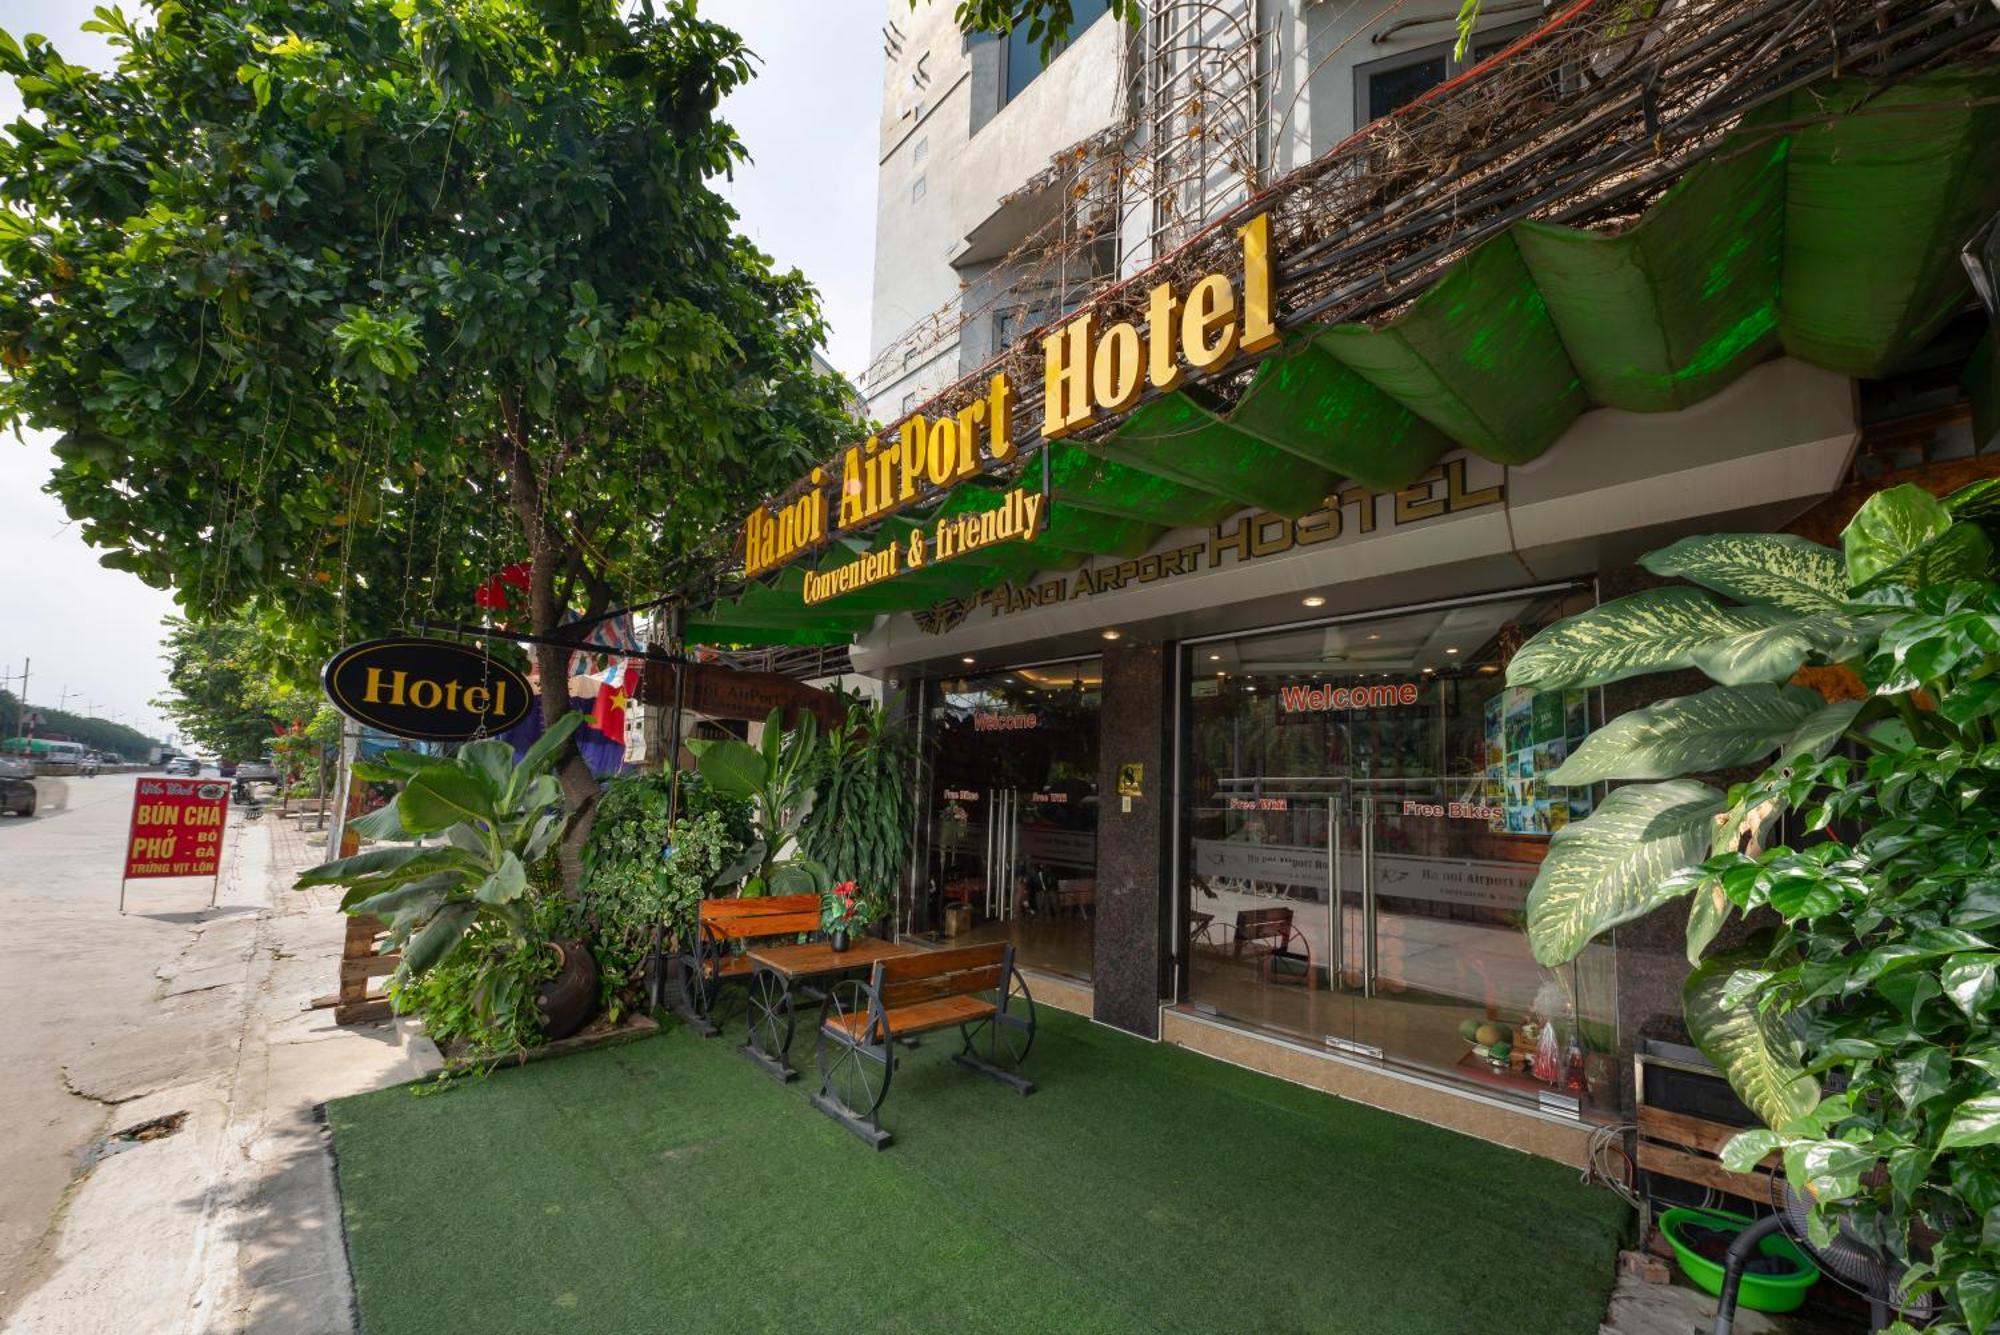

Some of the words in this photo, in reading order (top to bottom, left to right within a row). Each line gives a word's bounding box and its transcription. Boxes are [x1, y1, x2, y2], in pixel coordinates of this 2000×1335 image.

[745, 466, 827, 577] Hanoi
[1041, 211, 1279, 439] Hotel
[803, 540, 898, 605] Convenient
[907, 528, 925, 568] &
[935, 488, 1041, 560] friendly
[1070, 543, 1206, 600] AIRPORT
[1208, 458, 1505, 569] HOSTEL
[363, 667, 506, 716] Hotel
[1281, 683, 1418, 712] Welcome
[974, 711, 1037, 732] Welcome
[137, 801, 180, 826] BÚN
[1403, 800, 1444, 817] Free
[1448, 801, 1504, 819] Bikes
